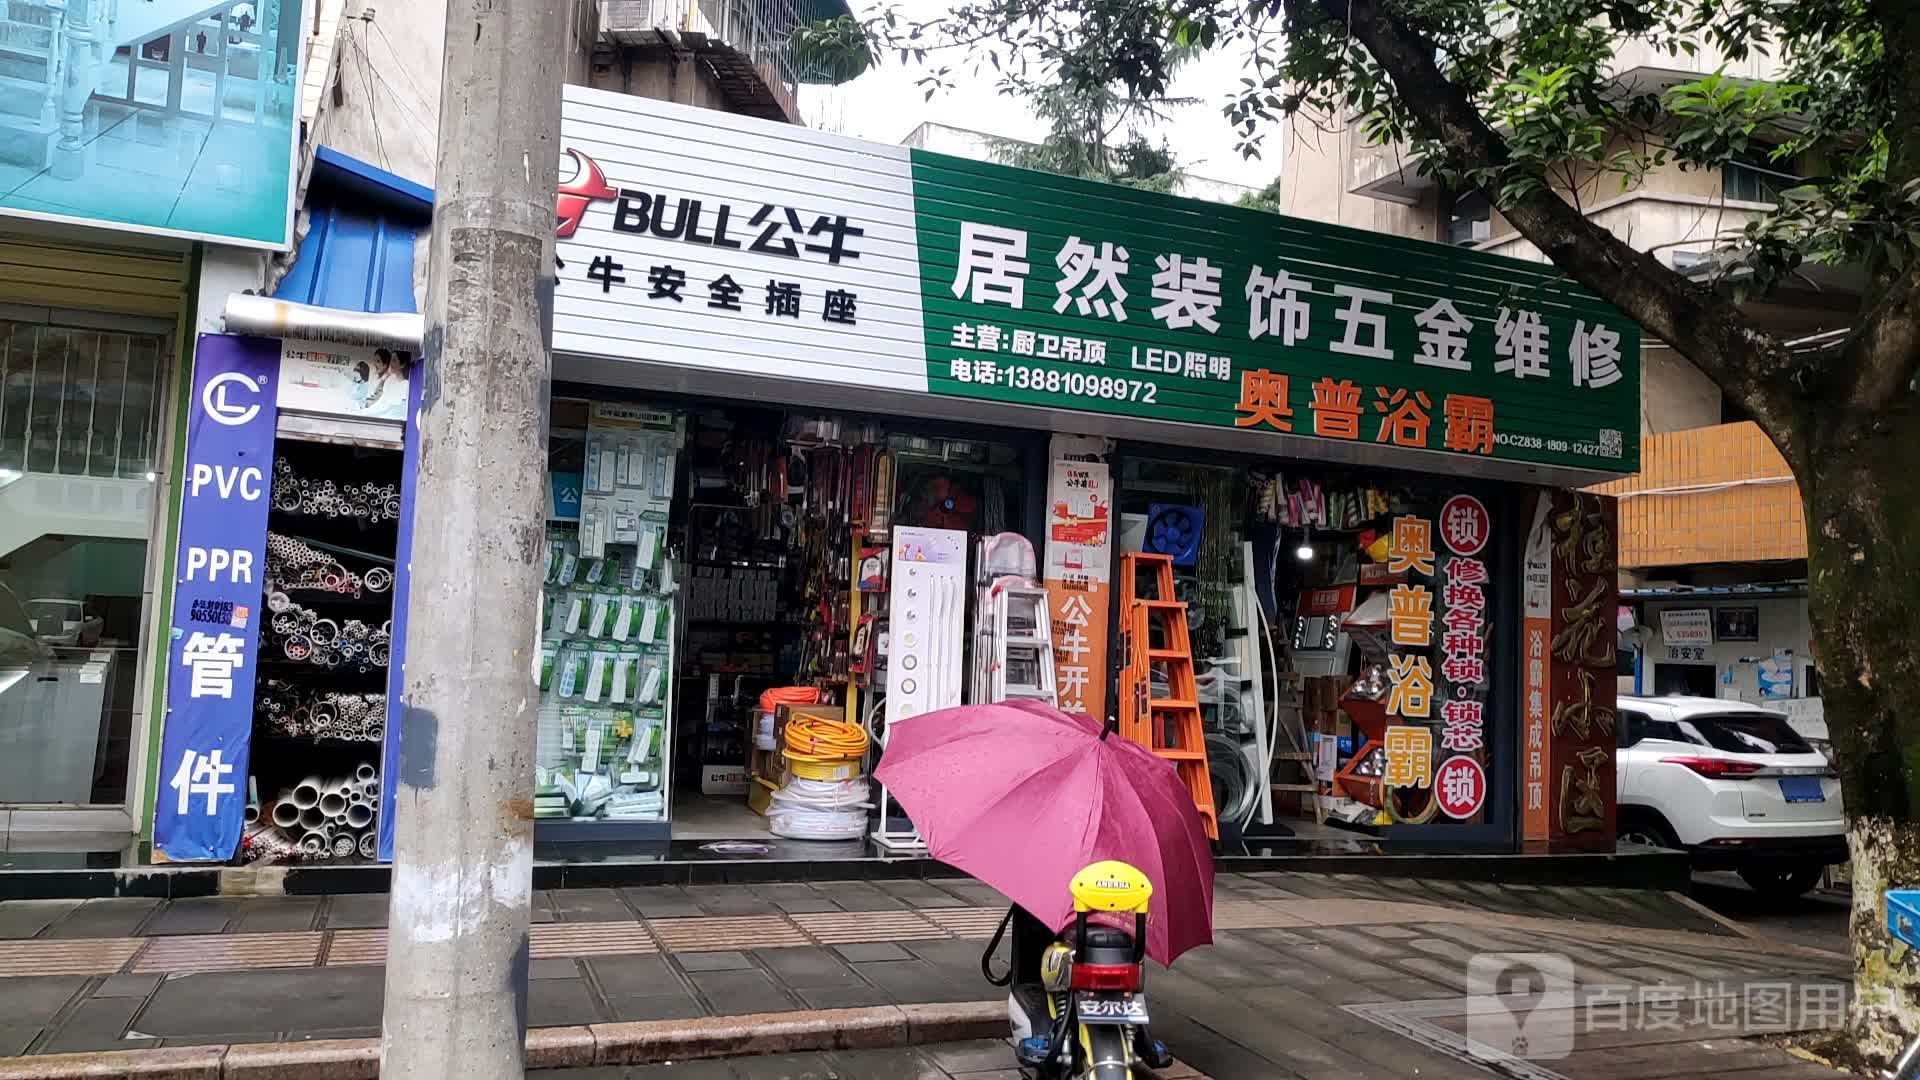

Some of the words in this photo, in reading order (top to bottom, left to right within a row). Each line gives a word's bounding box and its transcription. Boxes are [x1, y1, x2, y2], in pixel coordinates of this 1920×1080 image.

[555, 253, 858, 325] 牛安全插座
[951, 221, 1623, 389] 居然装饰五金维修
[951, 321, 1107, 366] 主营:厨卫吊顶
[1131, 346, 1232, 381] LED照明
[950, 357, 1157, 404] 电话:13881098972
[1235, 367, 1495, 455] 奥普浴霸
[191, 463, 262, 501] PVC
[1447, 505, 1479, 546] 锁
[186, 546, 254, 585] PPR
[1384, 514, 1436, 790] 奥普浴霸
[1527, 628, 1544, 812] 浴霸集成吊顶
[1442, 766, 1476, 808] 锁
[1080, 1000, 1145, 1016] 安尔达
